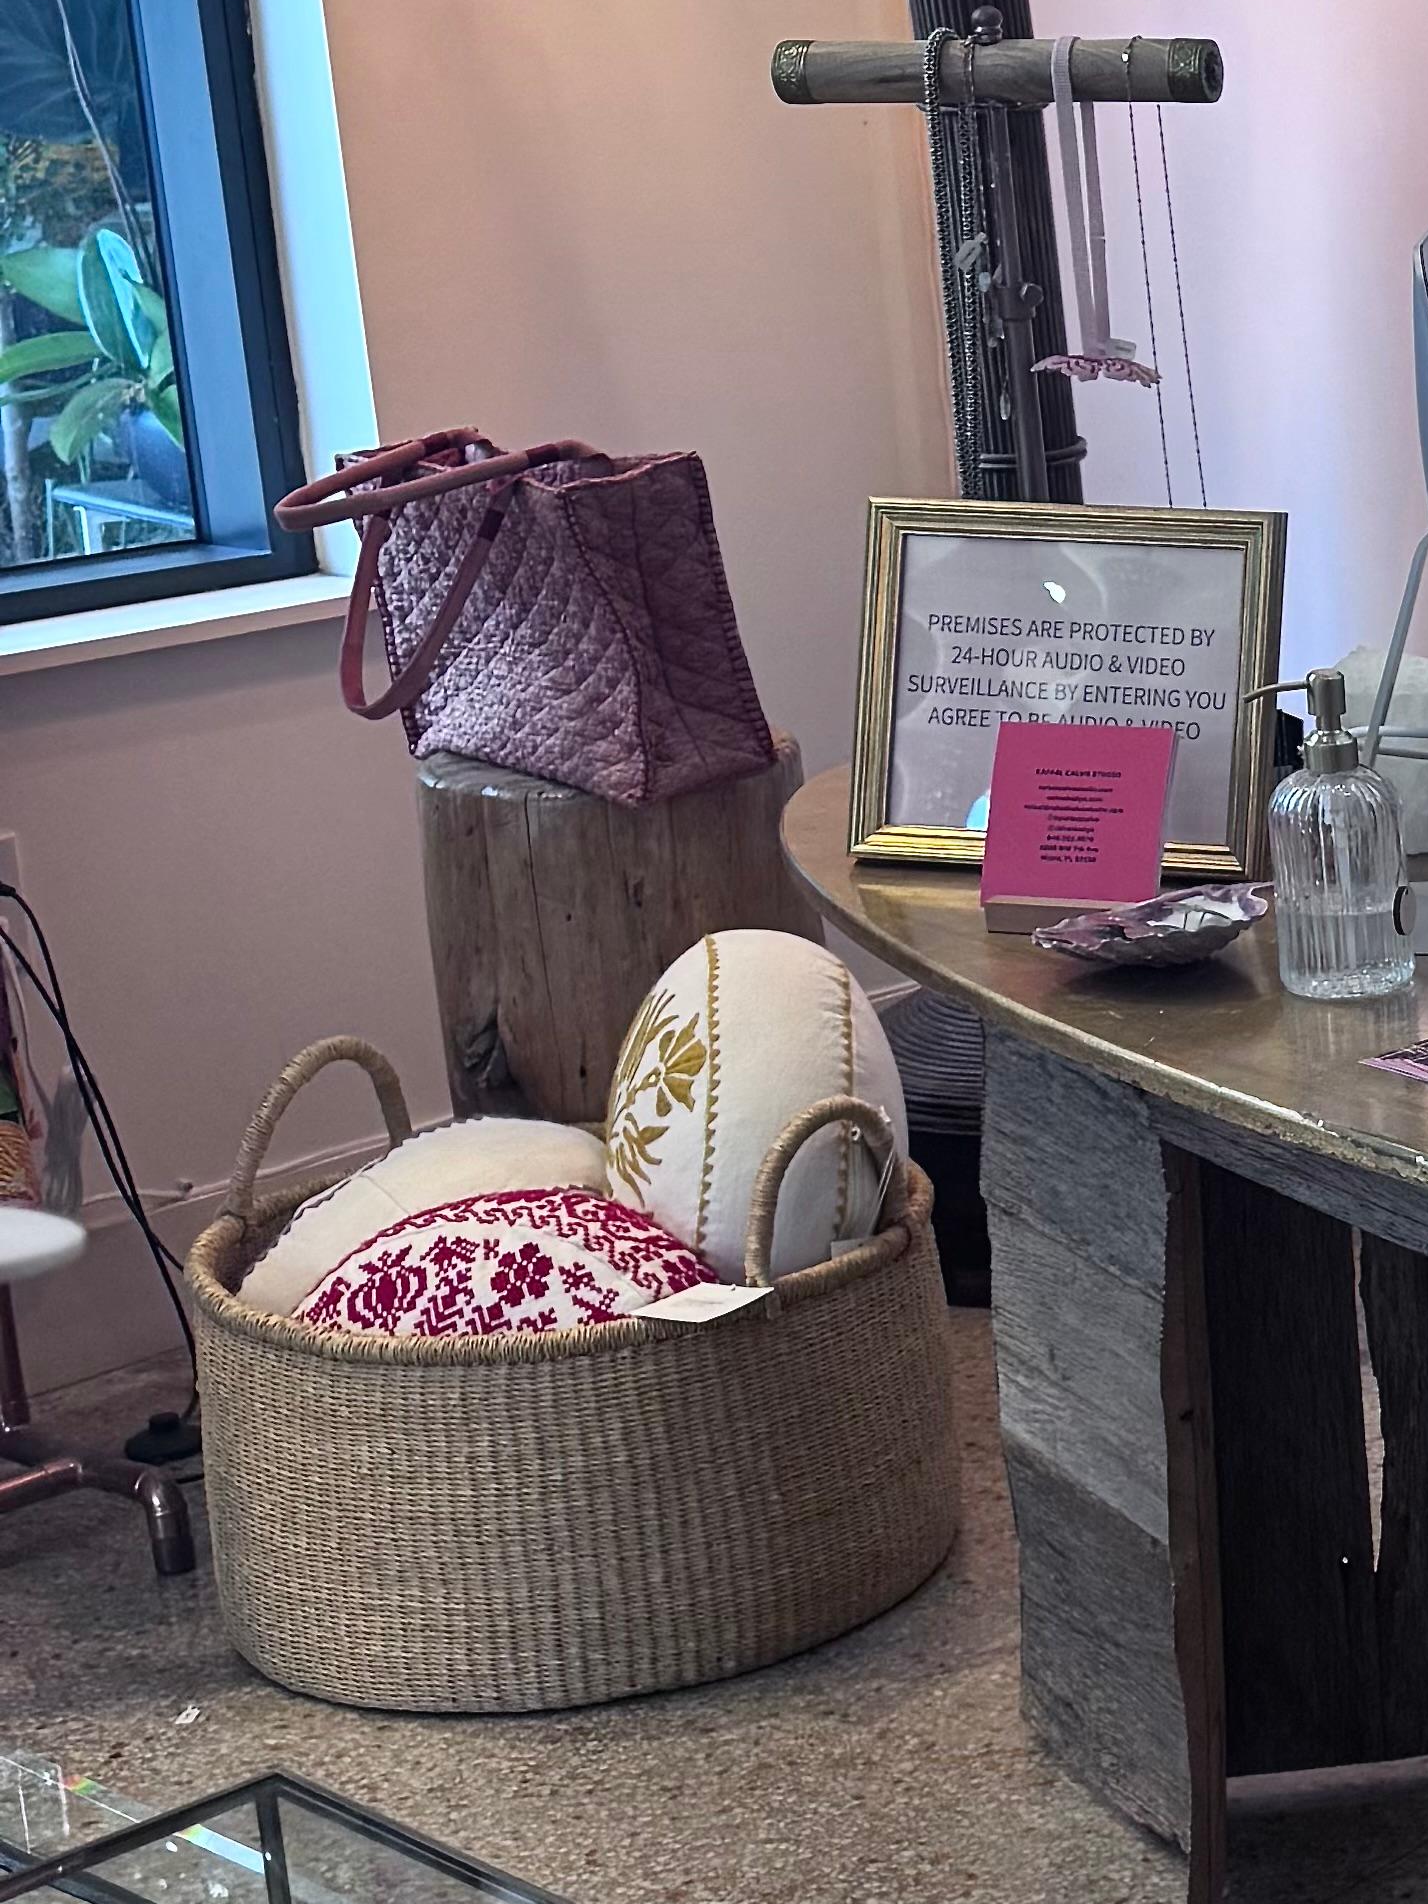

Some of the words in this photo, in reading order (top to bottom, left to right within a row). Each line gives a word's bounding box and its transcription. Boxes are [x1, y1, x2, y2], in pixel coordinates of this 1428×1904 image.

[928, 613, 1022, 637] PREMISES
[1026, 620, 1064, 639] ARE
[1069, 622, 1185, 646] PROTECTED
[1190, 628, 1216, 647] BY
[951, 646, 1037, 668] 24-HOUR
[1041, 653, 1103, 671] AUDIO
[1108, 656, 1122, 673] &
[1127, 656, 1186, 677] VIDEO
[907, 674, 1047, 700] SURVEILLANCE
[1054, 683, 1079, 701] BY
[1083, 685, 1181, 708] ENTERING
[1185, 691, 1227, 711] YOU
[927, 706, 991, 728] AGREE
